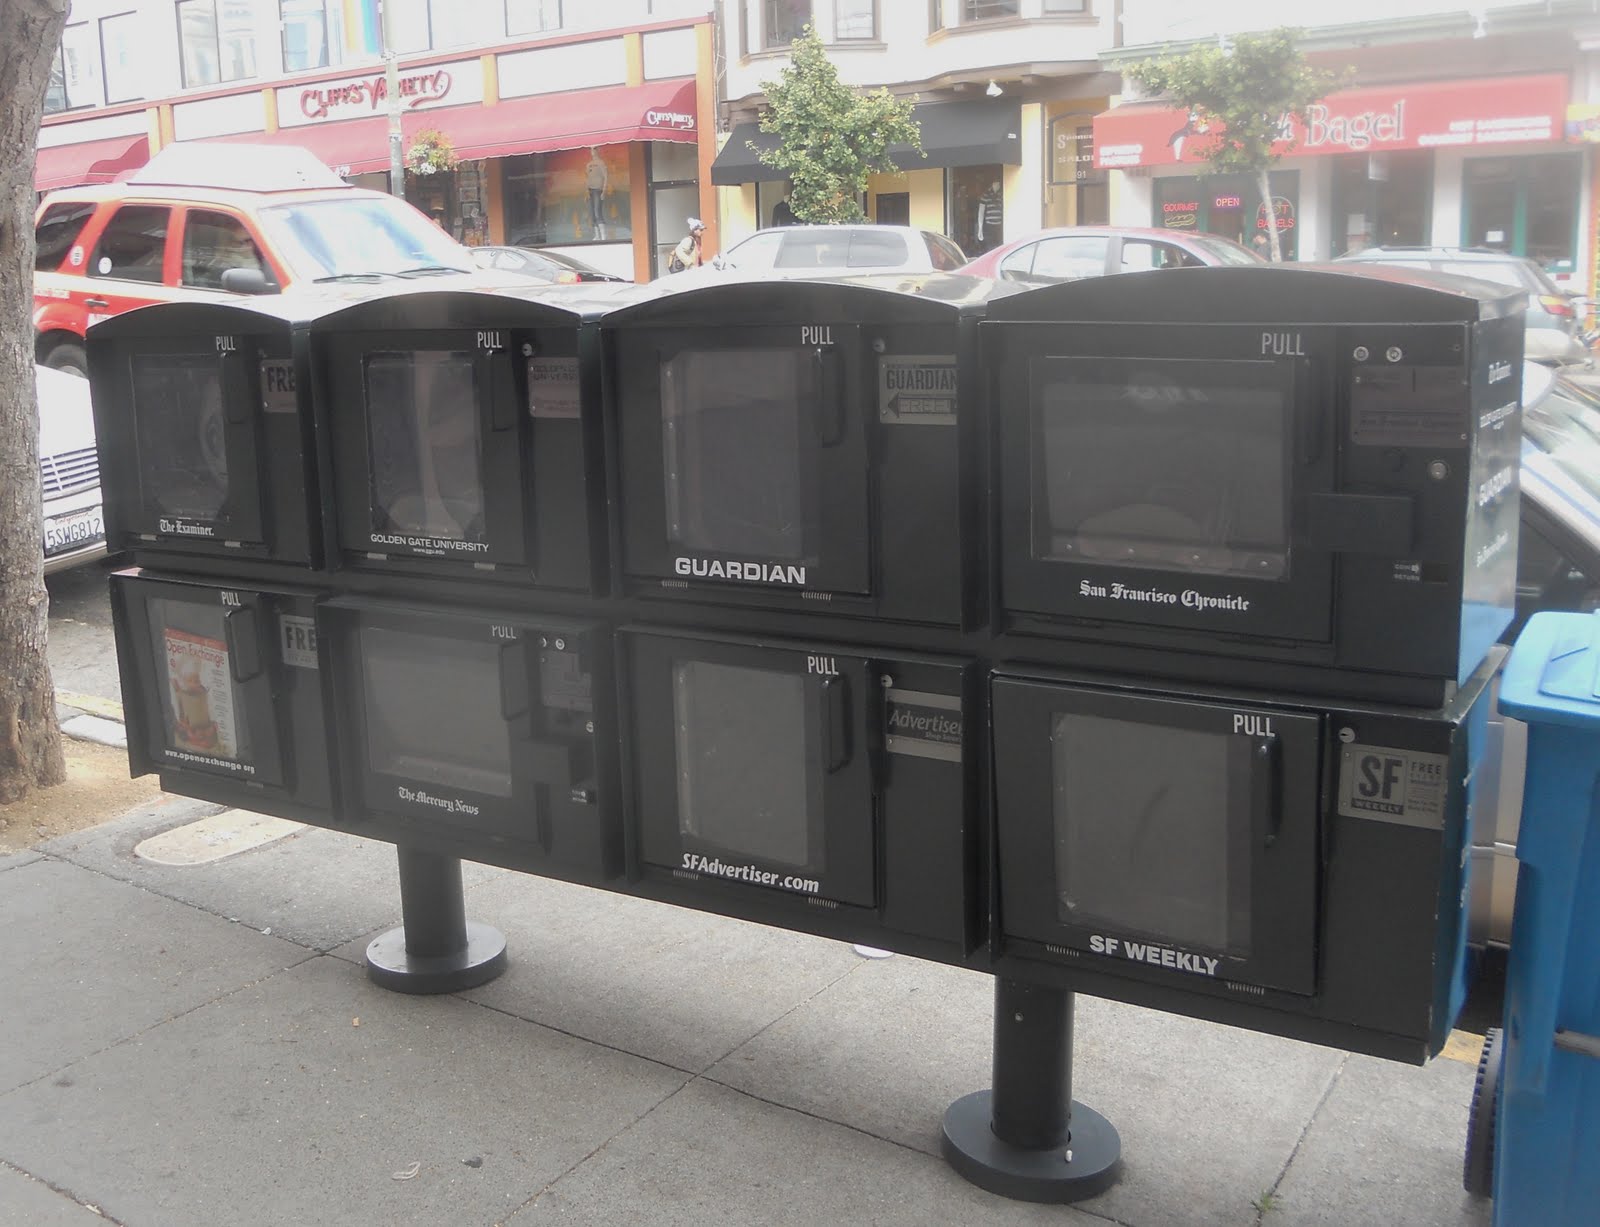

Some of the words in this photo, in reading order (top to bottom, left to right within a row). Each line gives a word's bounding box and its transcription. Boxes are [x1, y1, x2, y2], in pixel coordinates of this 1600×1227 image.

[362, 70, 453, 110] VAIETY
[1303, 99, 1406, 150] Bagel
[1162, 202, 1200, 213] GOURMET
[1215, 198, 1240, 207] OPEN
[1256, 218, 1295, 228] BAELS
[215, 335, 236, 351] PULL
[478, 331, 503, 348] PULL
[801, 325, 834, 345] PULL
[1261, 332, 1305, 356] PULL
[46, 517, 102, 548] 5SWG812
[160, 519, 175, 533] The
[370, 533, 407, 545] GOLDEN
[408, 537, 432, 548] GATE
[433, 539, 490, 553] UNIVERSITY
[675, 557, 806, 584] GUARDIAN
[222, 591, 242, 606] PULL
[1080, 579, 1106, 597] San
[1110, 582, 1177, 604] Francisco
[1181, 589, 1250, 611] Chronicle
[492, 624, 517, 640] PULL
[166, 639, 187, 657] Open
[808, 655, 840, 676] PULL
[1233, 713, 1276, 738] PULL
[1359, 755, 1403, 799] SF
[398, 786, 415, 802] The
[416, 790, 455, 812] Mercury
[455, 799, 480, 815] News
[682, 853, 820, 893] SFAdvertiser.com
[1089, 934, 1119, 955] SF
[1123, 940, 1219, 976] WEEKLY
